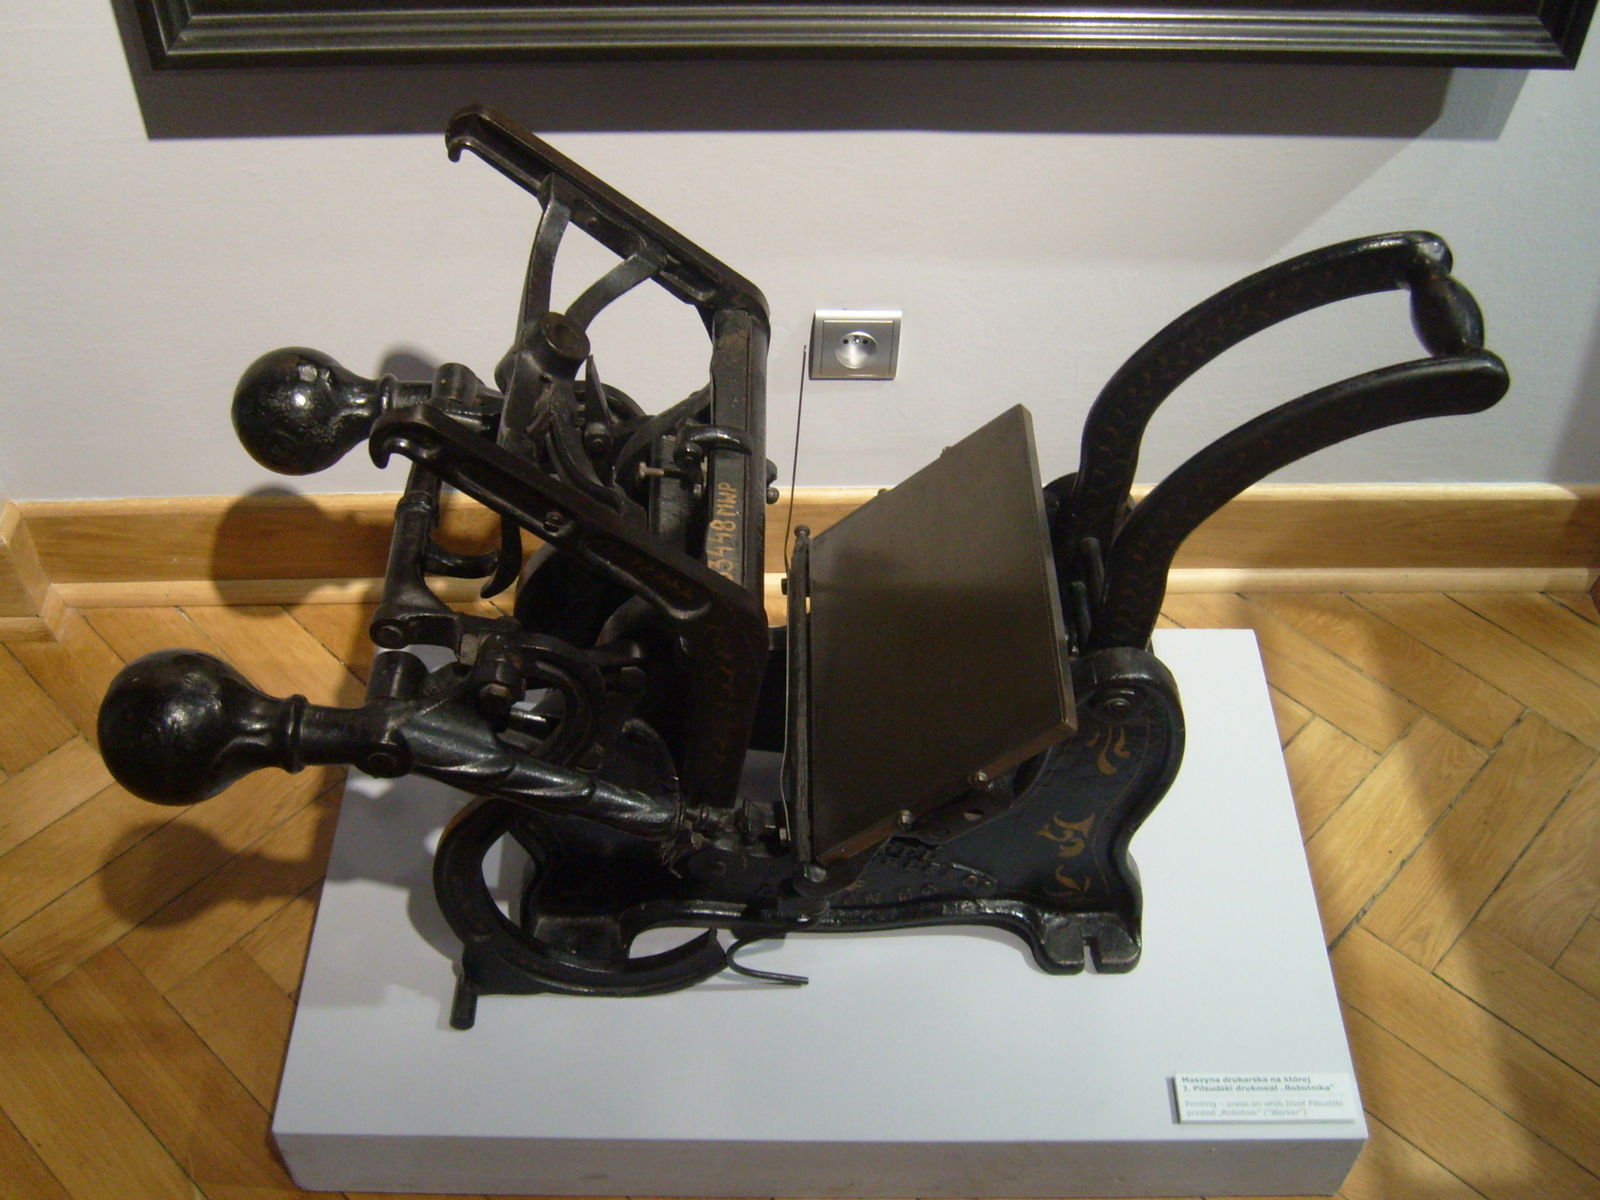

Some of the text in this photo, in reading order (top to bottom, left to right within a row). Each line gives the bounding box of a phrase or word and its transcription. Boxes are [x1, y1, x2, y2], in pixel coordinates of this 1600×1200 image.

[1181, 1076, 1221, 1084] Maszyna
[1223, 1075, 1268, 1083] drukarska
[1284, 1075, 1311, 1084] której
